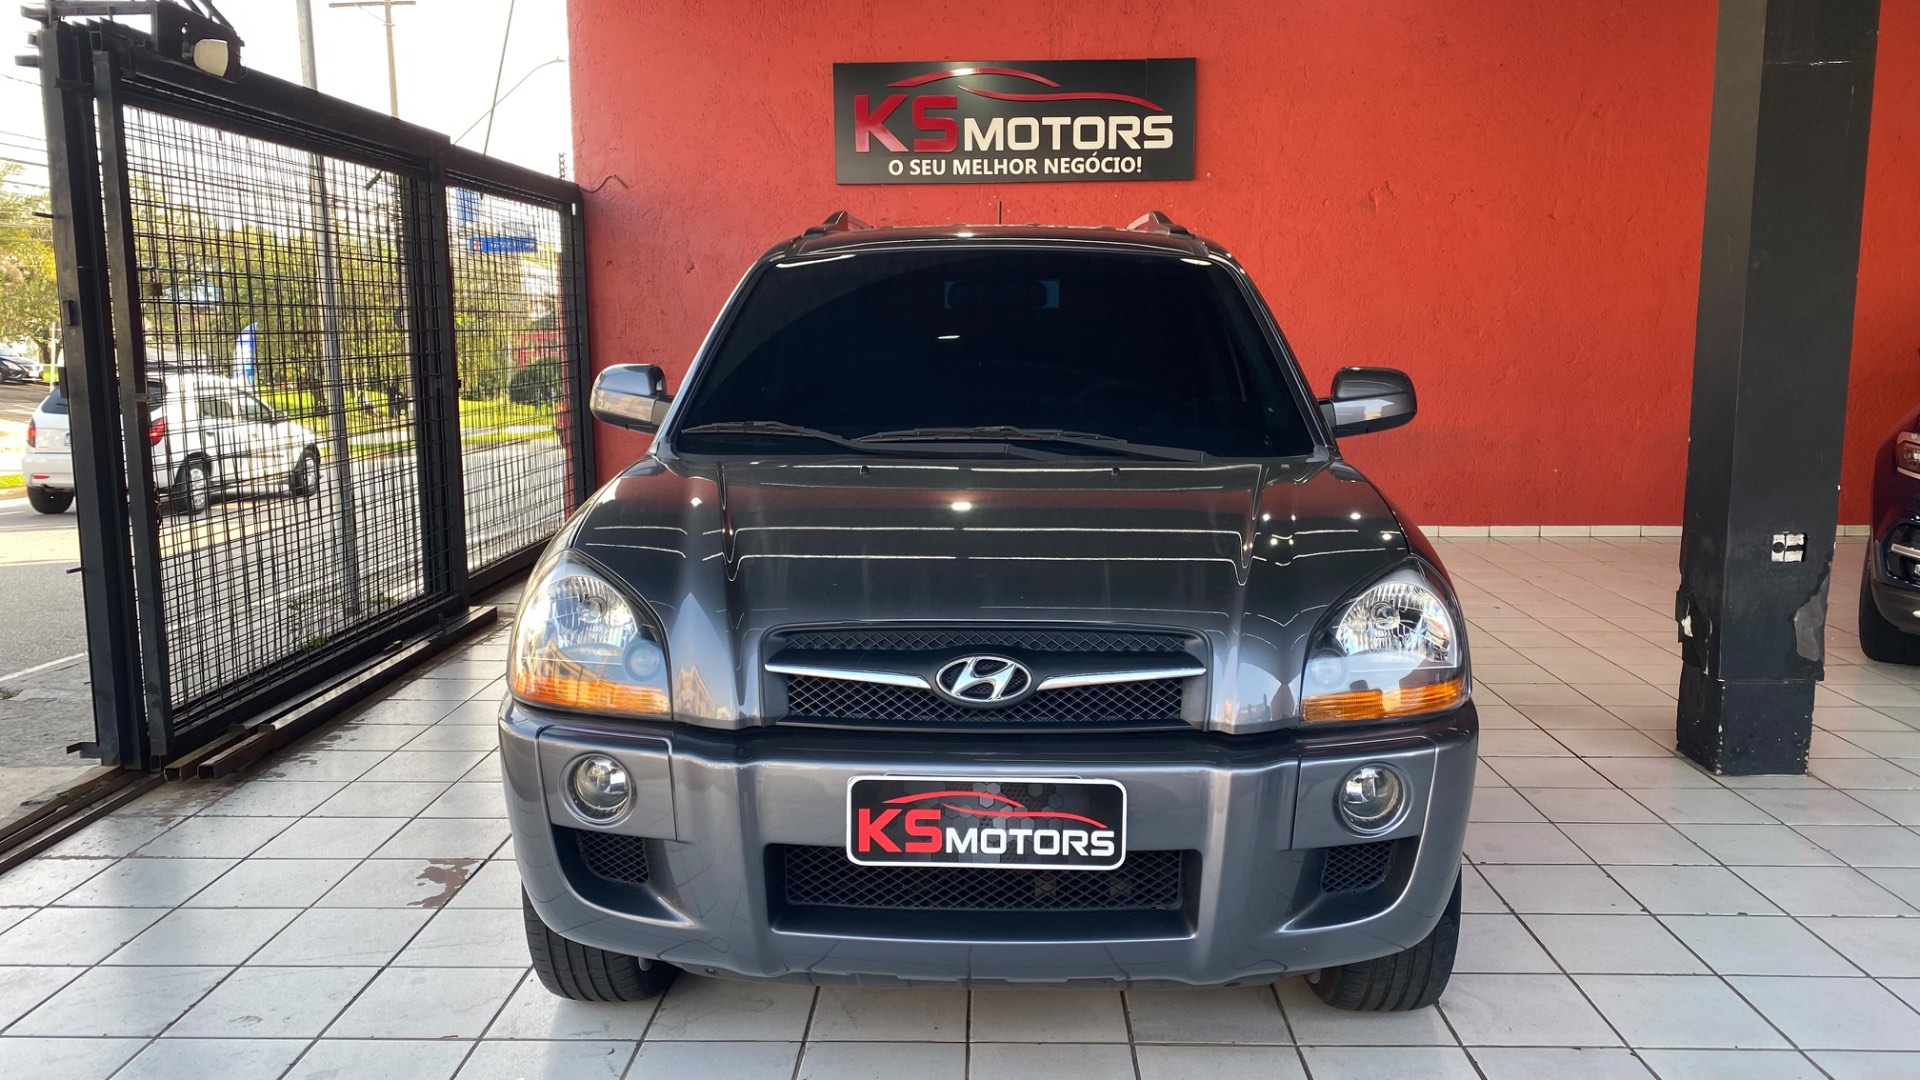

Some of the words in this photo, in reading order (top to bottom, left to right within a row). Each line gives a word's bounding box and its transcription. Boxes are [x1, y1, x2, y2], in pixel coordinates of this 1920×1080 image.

[853, 94, 960, 153] KS
[963, 114, 1174, 151] MOTORS
[888, 159, 904, 176] O
[909, 159, 946, 176] SEU
[952, 158, 1037, 176] MELHOR
[1043, 152, 1143, 175] NEGÓCIO!
[857, 807, 943, 853] KS
[945, 827, 1116, 857] MOTORS
